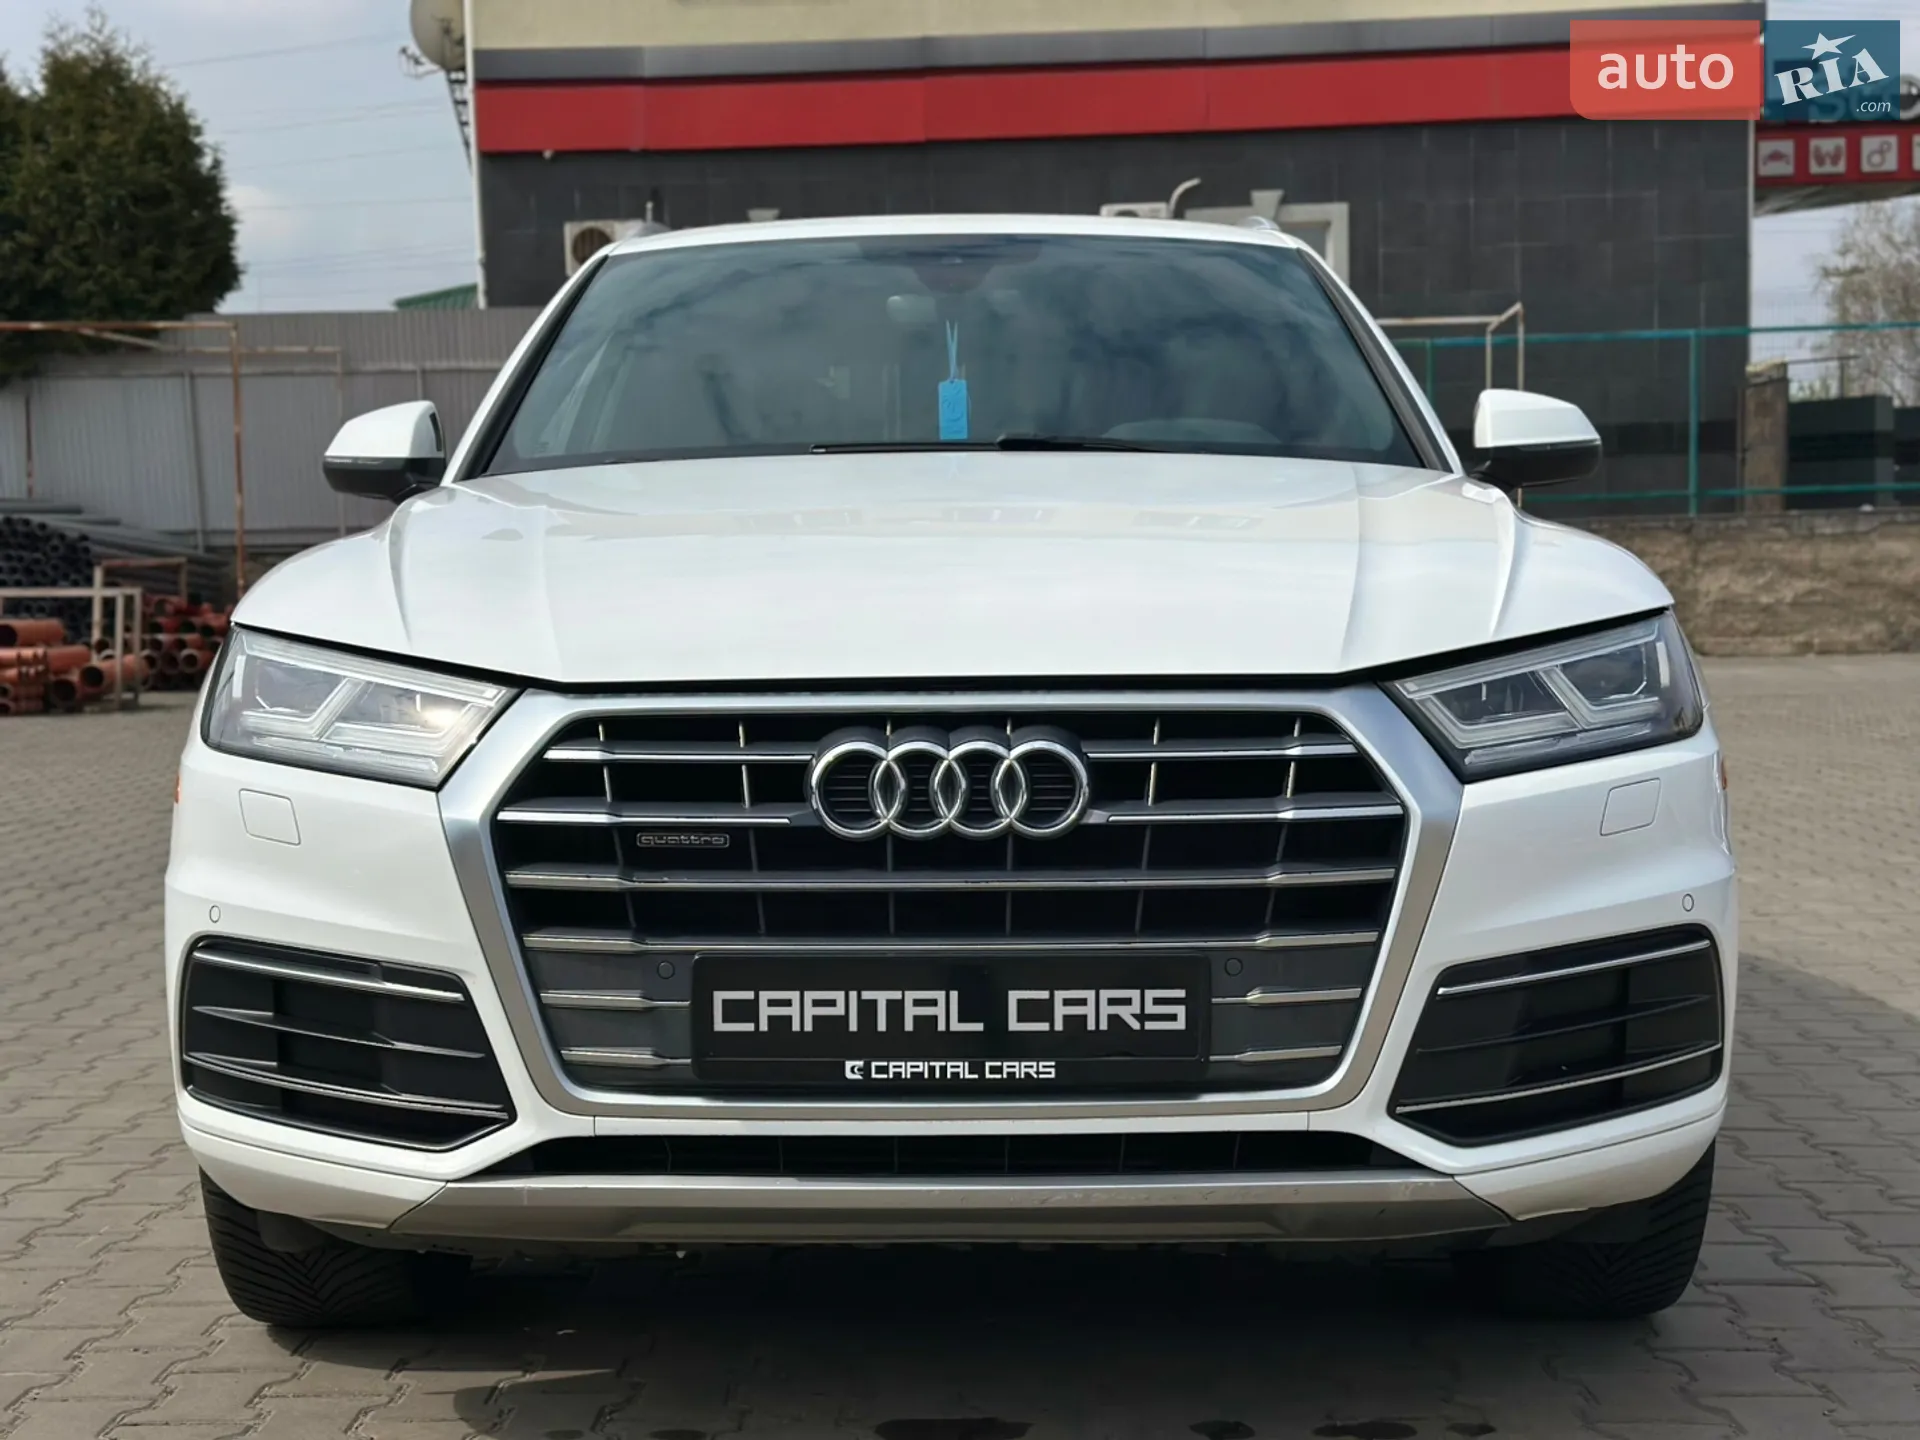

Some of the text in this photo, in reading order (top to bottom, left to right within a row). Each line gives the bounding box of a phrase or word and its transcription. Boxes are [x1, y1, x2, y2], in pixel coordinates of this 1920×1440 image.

[640, 835, 725, 846] quattro
[712, 989, 1187, 1032] CAPITAL CARS
[870, 1060, 1056, 1080] CAPITAL CARS
